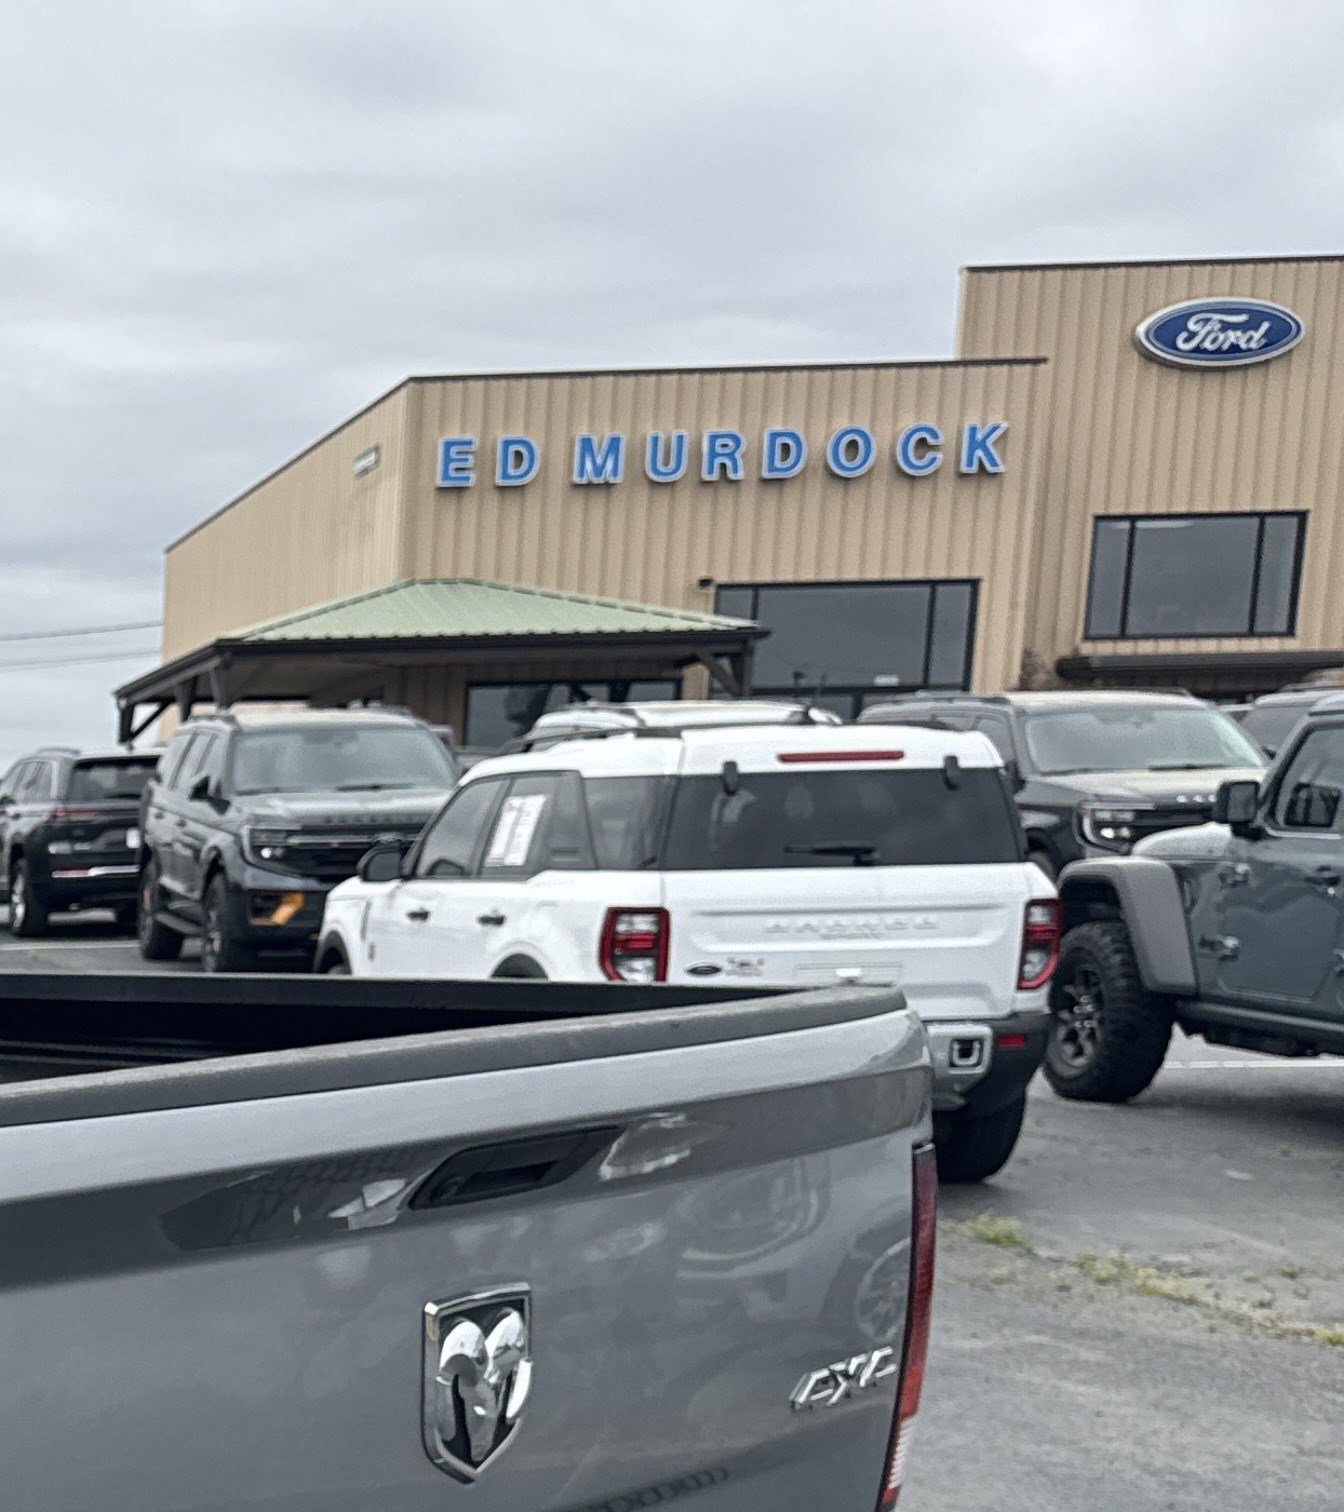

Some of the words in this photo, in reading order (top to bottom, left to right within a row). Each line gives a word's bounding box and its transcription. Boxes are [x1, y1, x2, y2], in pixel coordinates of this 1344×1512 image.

[1175, 312, 1271, 351] Ford
[437, 432, 540, 488] ED
[572, 420, 1009, 484] MURDOCK
